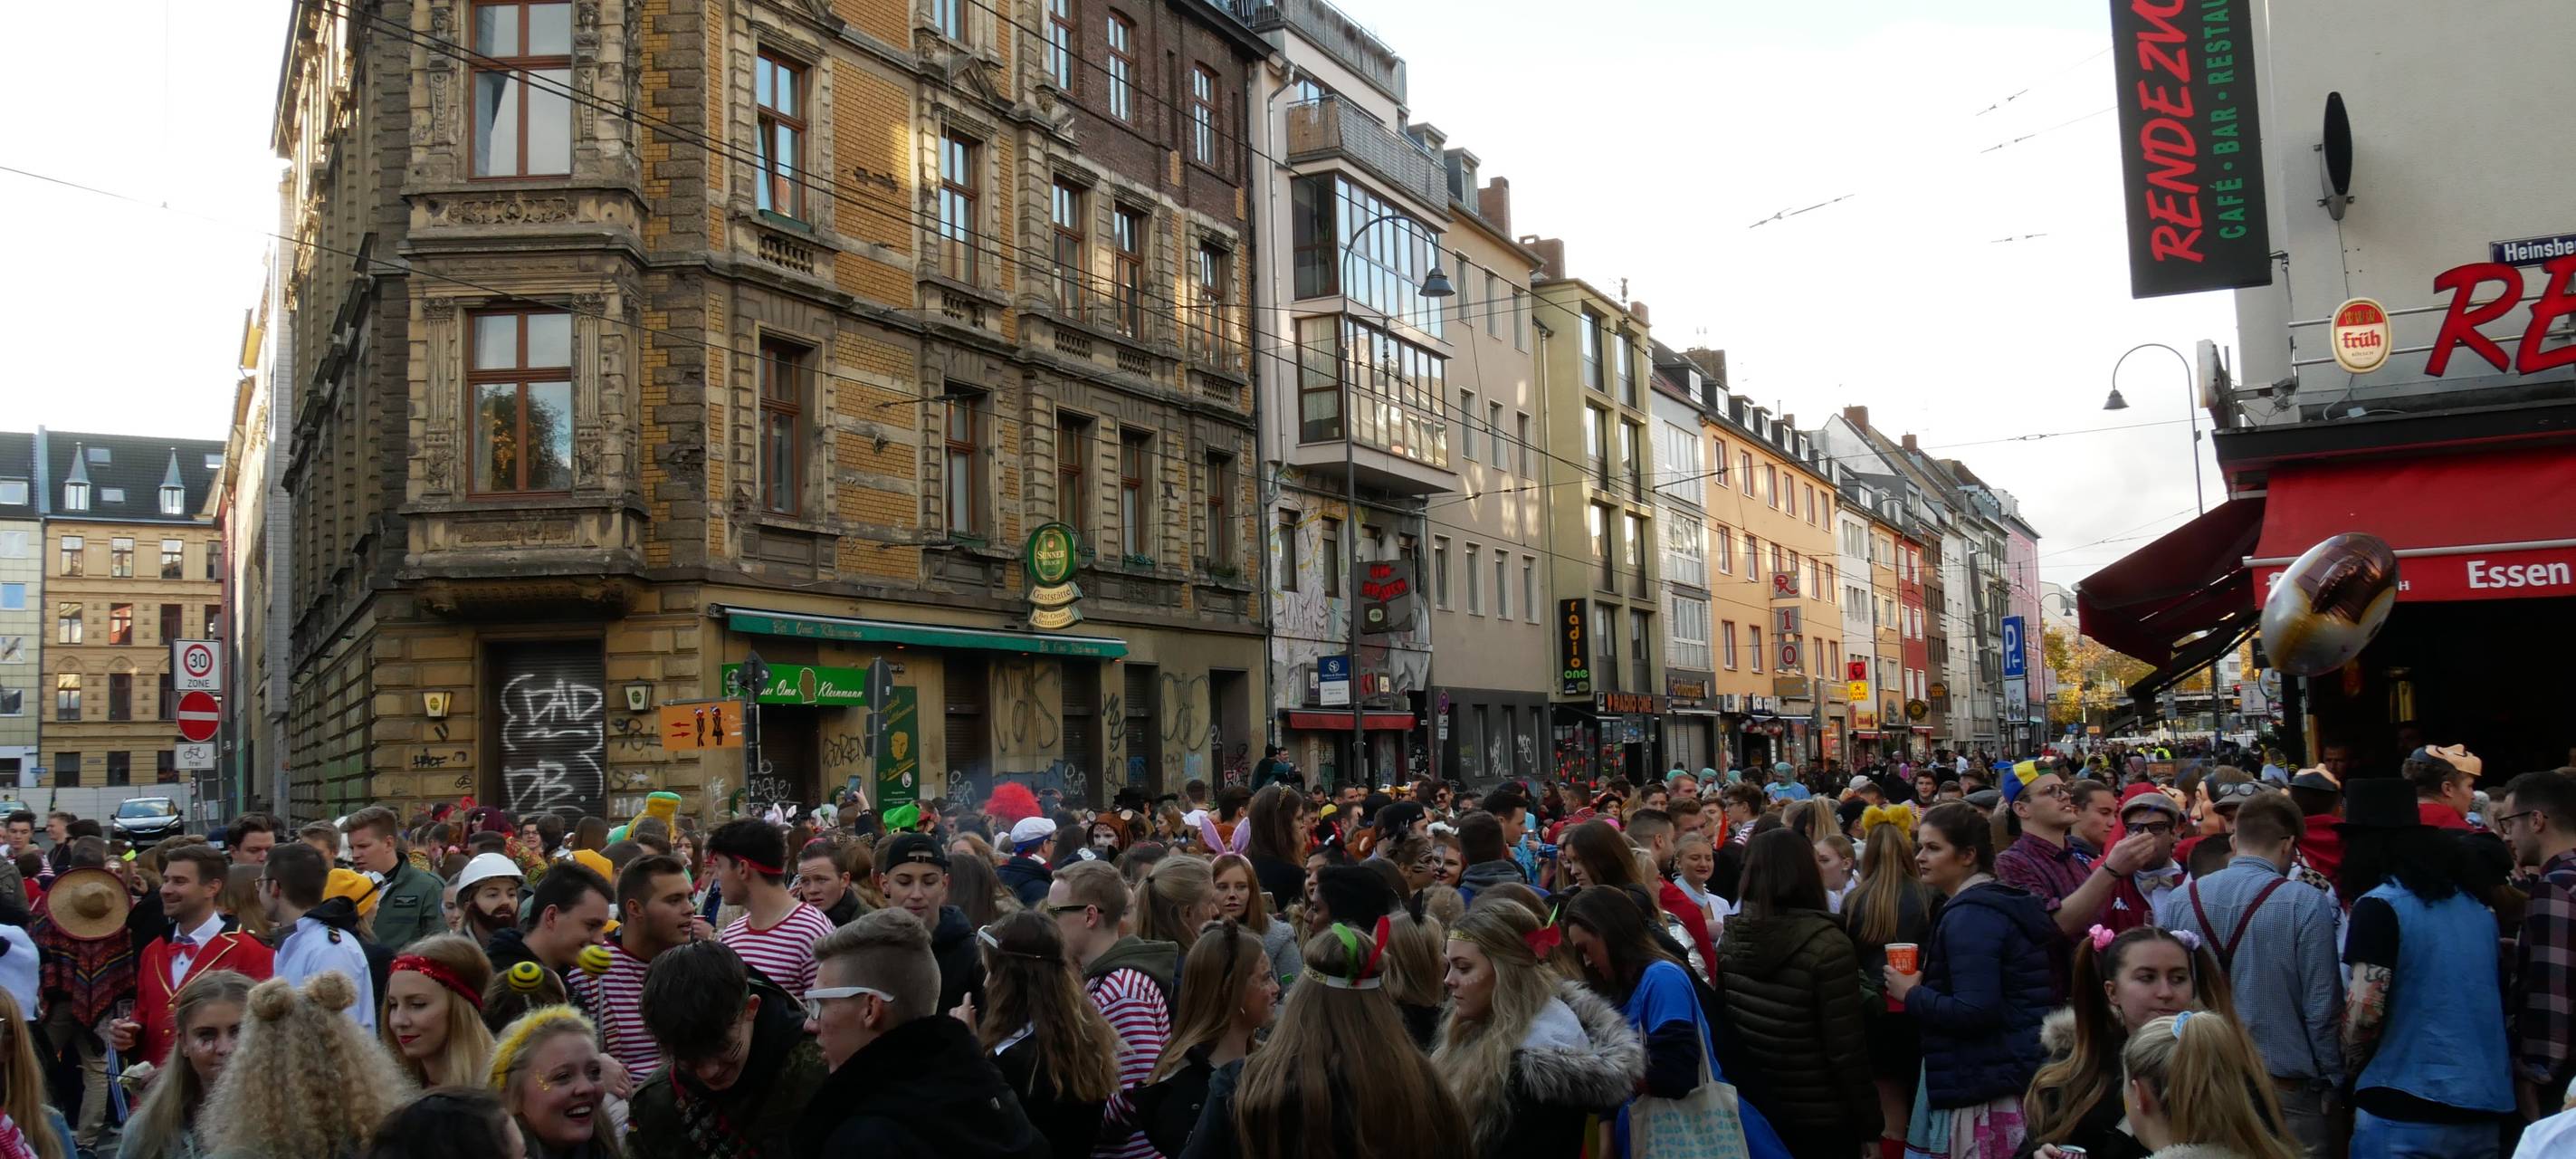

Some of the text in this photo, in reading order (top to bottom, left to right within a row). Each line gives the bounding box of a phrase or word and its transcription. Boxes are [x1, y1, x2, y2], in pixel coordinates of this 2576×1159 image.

[2210, 106, 2239, 155] BAR
[2209, 177, 2247, 239] CAFÉ
[2504, 237, 2576, 262] Heinsbe
[2466, 560, 2570, 589] Essen
[1033, 589, 1072, 601] Gaststätte
[1569, 600, 1581, 668] radio
[2005, 624, 2017, 669] P
[189, 653, 207, 668] 30
[187, 679, 210, 688] ZONE
[1563, 669, 1589, 679] one
[777, 679, 797, 696] Oma
[818, 681, 863, 698] Kleinmann
[1614, 694, 1652, 714] RADIO ONE
